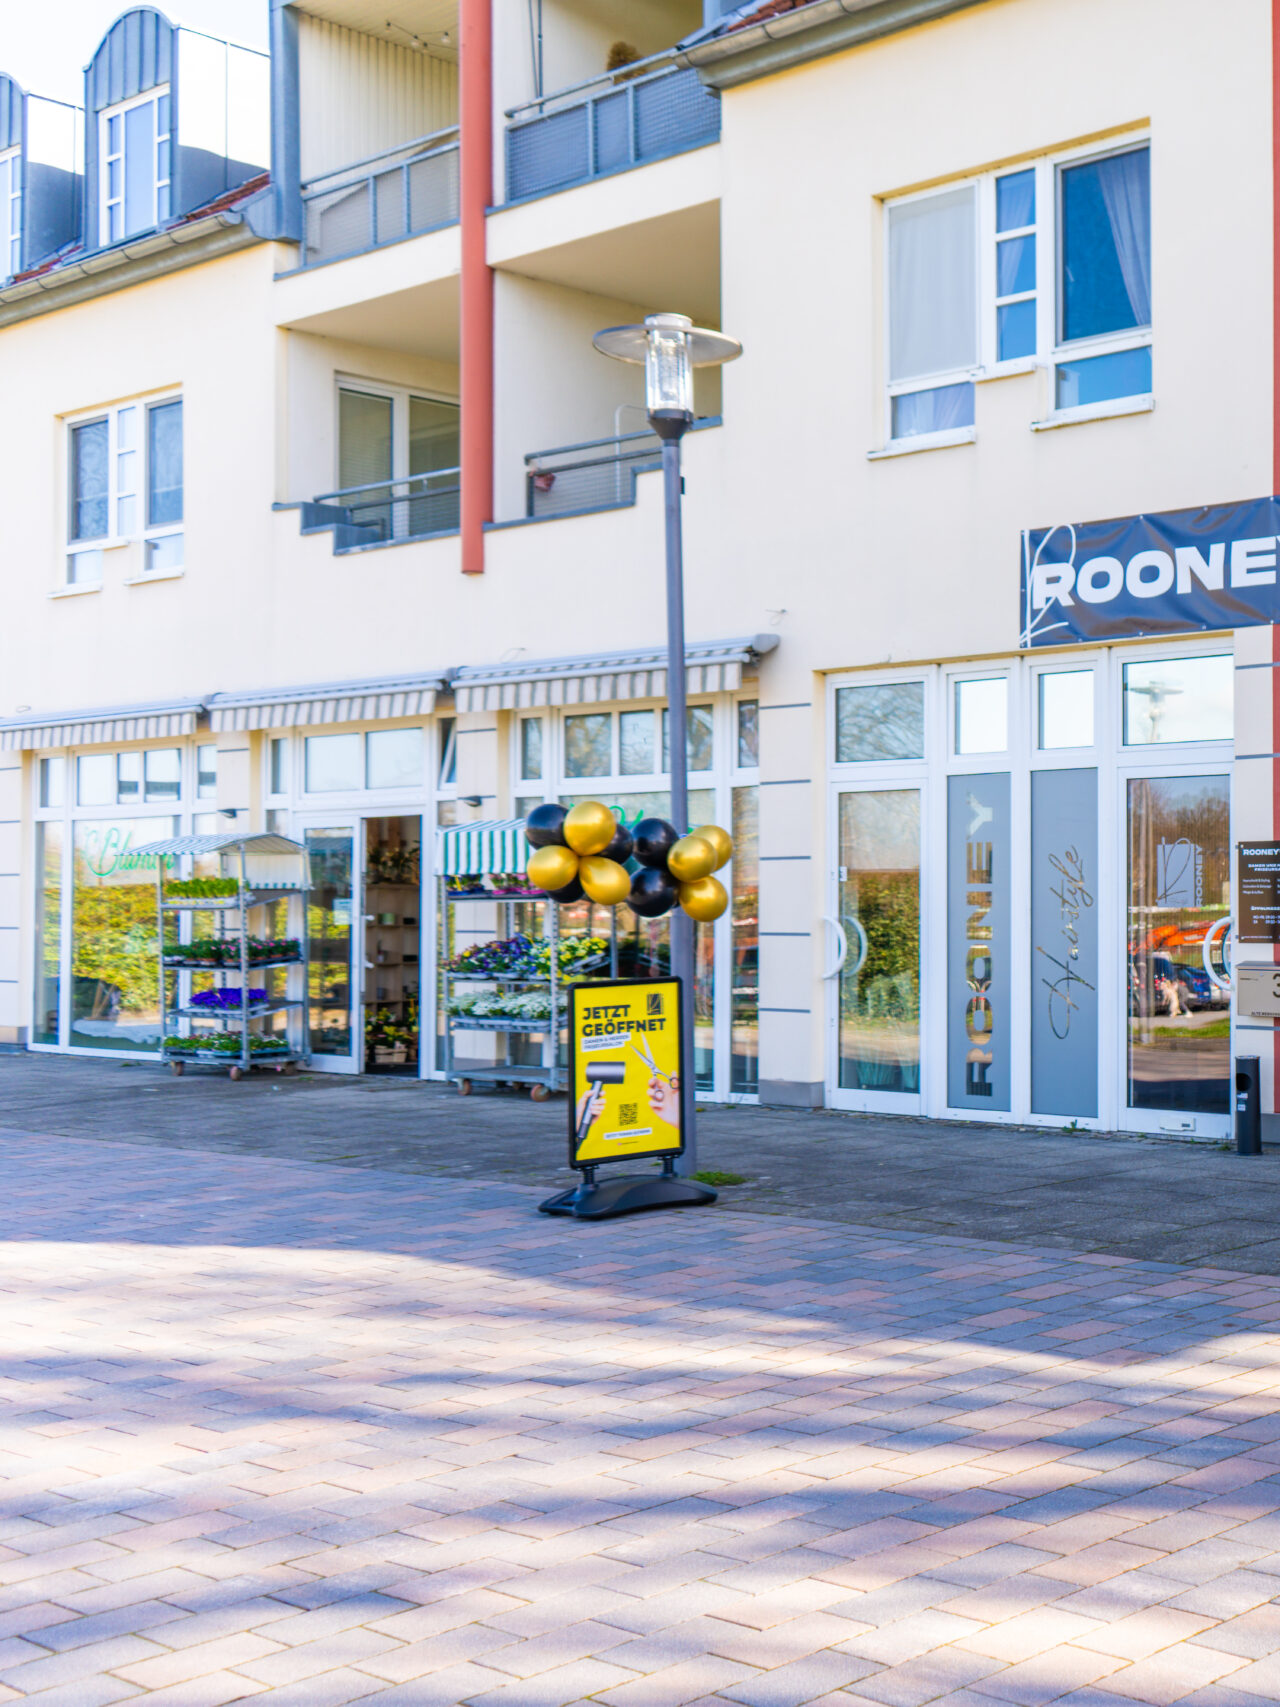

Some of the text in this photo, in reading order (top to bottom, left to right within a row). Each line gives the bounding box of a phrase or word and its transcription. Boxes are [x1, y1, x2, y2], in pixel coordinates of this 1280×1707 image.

[1242, 848, 1279, 856] ROONEY
[966, 791, 993, 1097] ROONEY
[1037, 845, 1095, 1040] Hairstyle
[582, 1004, 631, 1021] JETZT
[581, 1018, 667, 1037] GEÖFFNET
